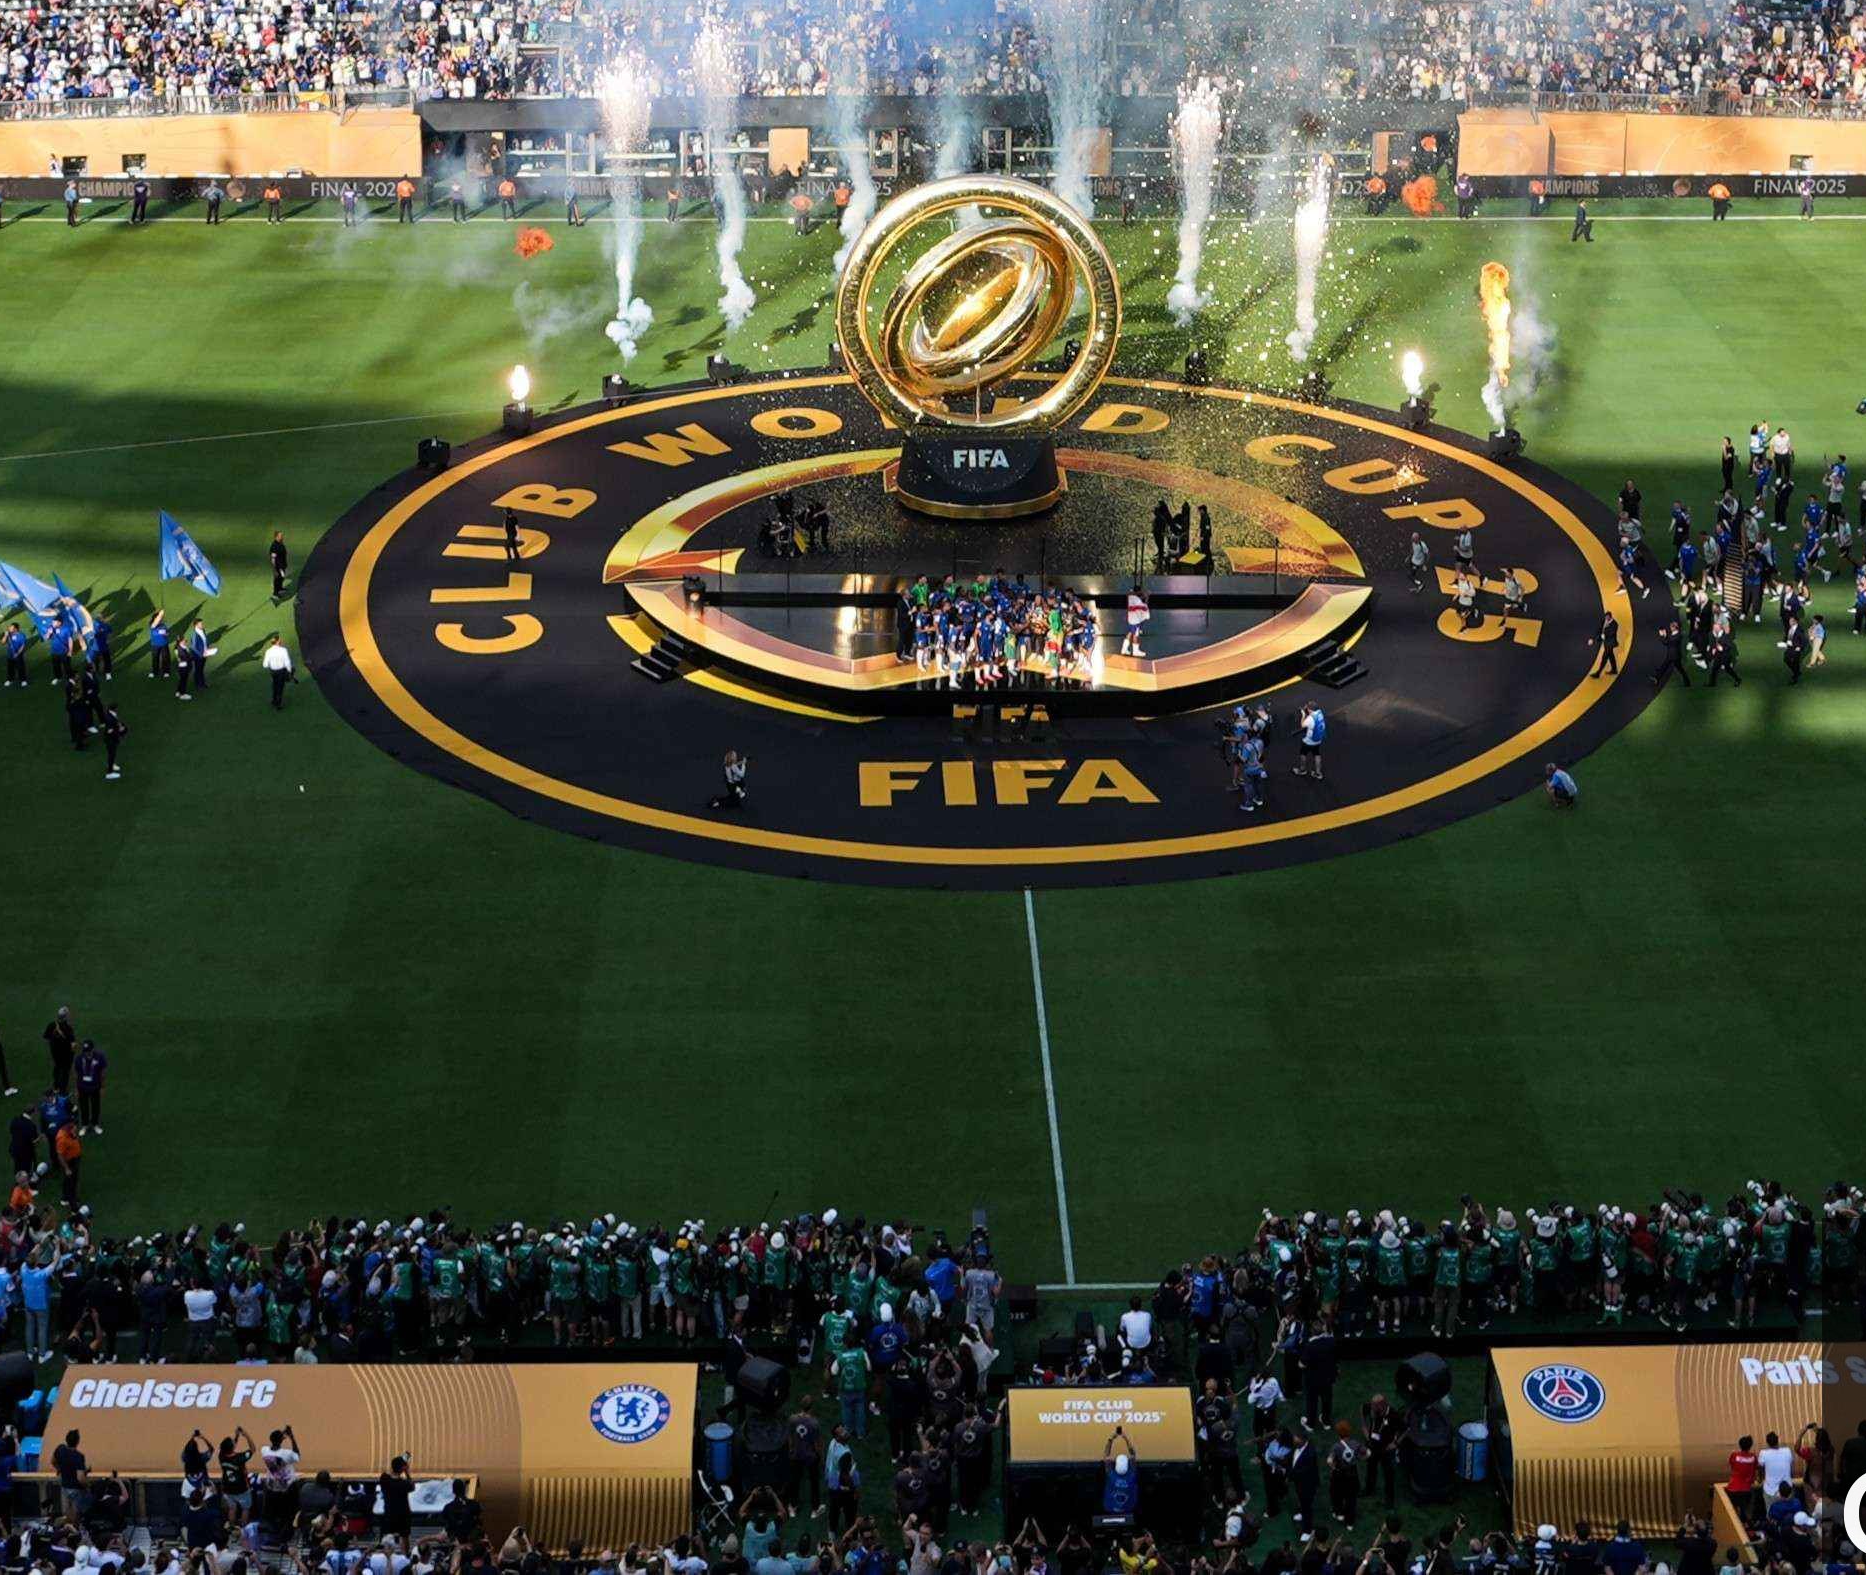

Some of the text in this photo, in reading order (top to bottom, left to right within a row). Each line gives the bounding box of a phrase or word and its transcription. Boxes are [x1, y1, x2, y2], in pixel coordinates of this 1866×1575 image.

[365, 181, 397, 197] 202
[794, 180, 837, 196] FINA
[1545, 180, 1600, 196] AMPIONS
[952, 448, 1010, 470] FIFA
[429, 403, 1543, 655] CLUB WOD CUP 25
[858, 758, 1162, 807] FIFA
[1739, 1354, 1840, 1386] Paris
[69, 1377, 278, 1409] Chelsea FC
[1063, 1399, 1134, 1410] FIFA CLUB
[1038, 1412, 1090, 1424] WORLD
[1092, 1412, 1123, 1424] CUP
